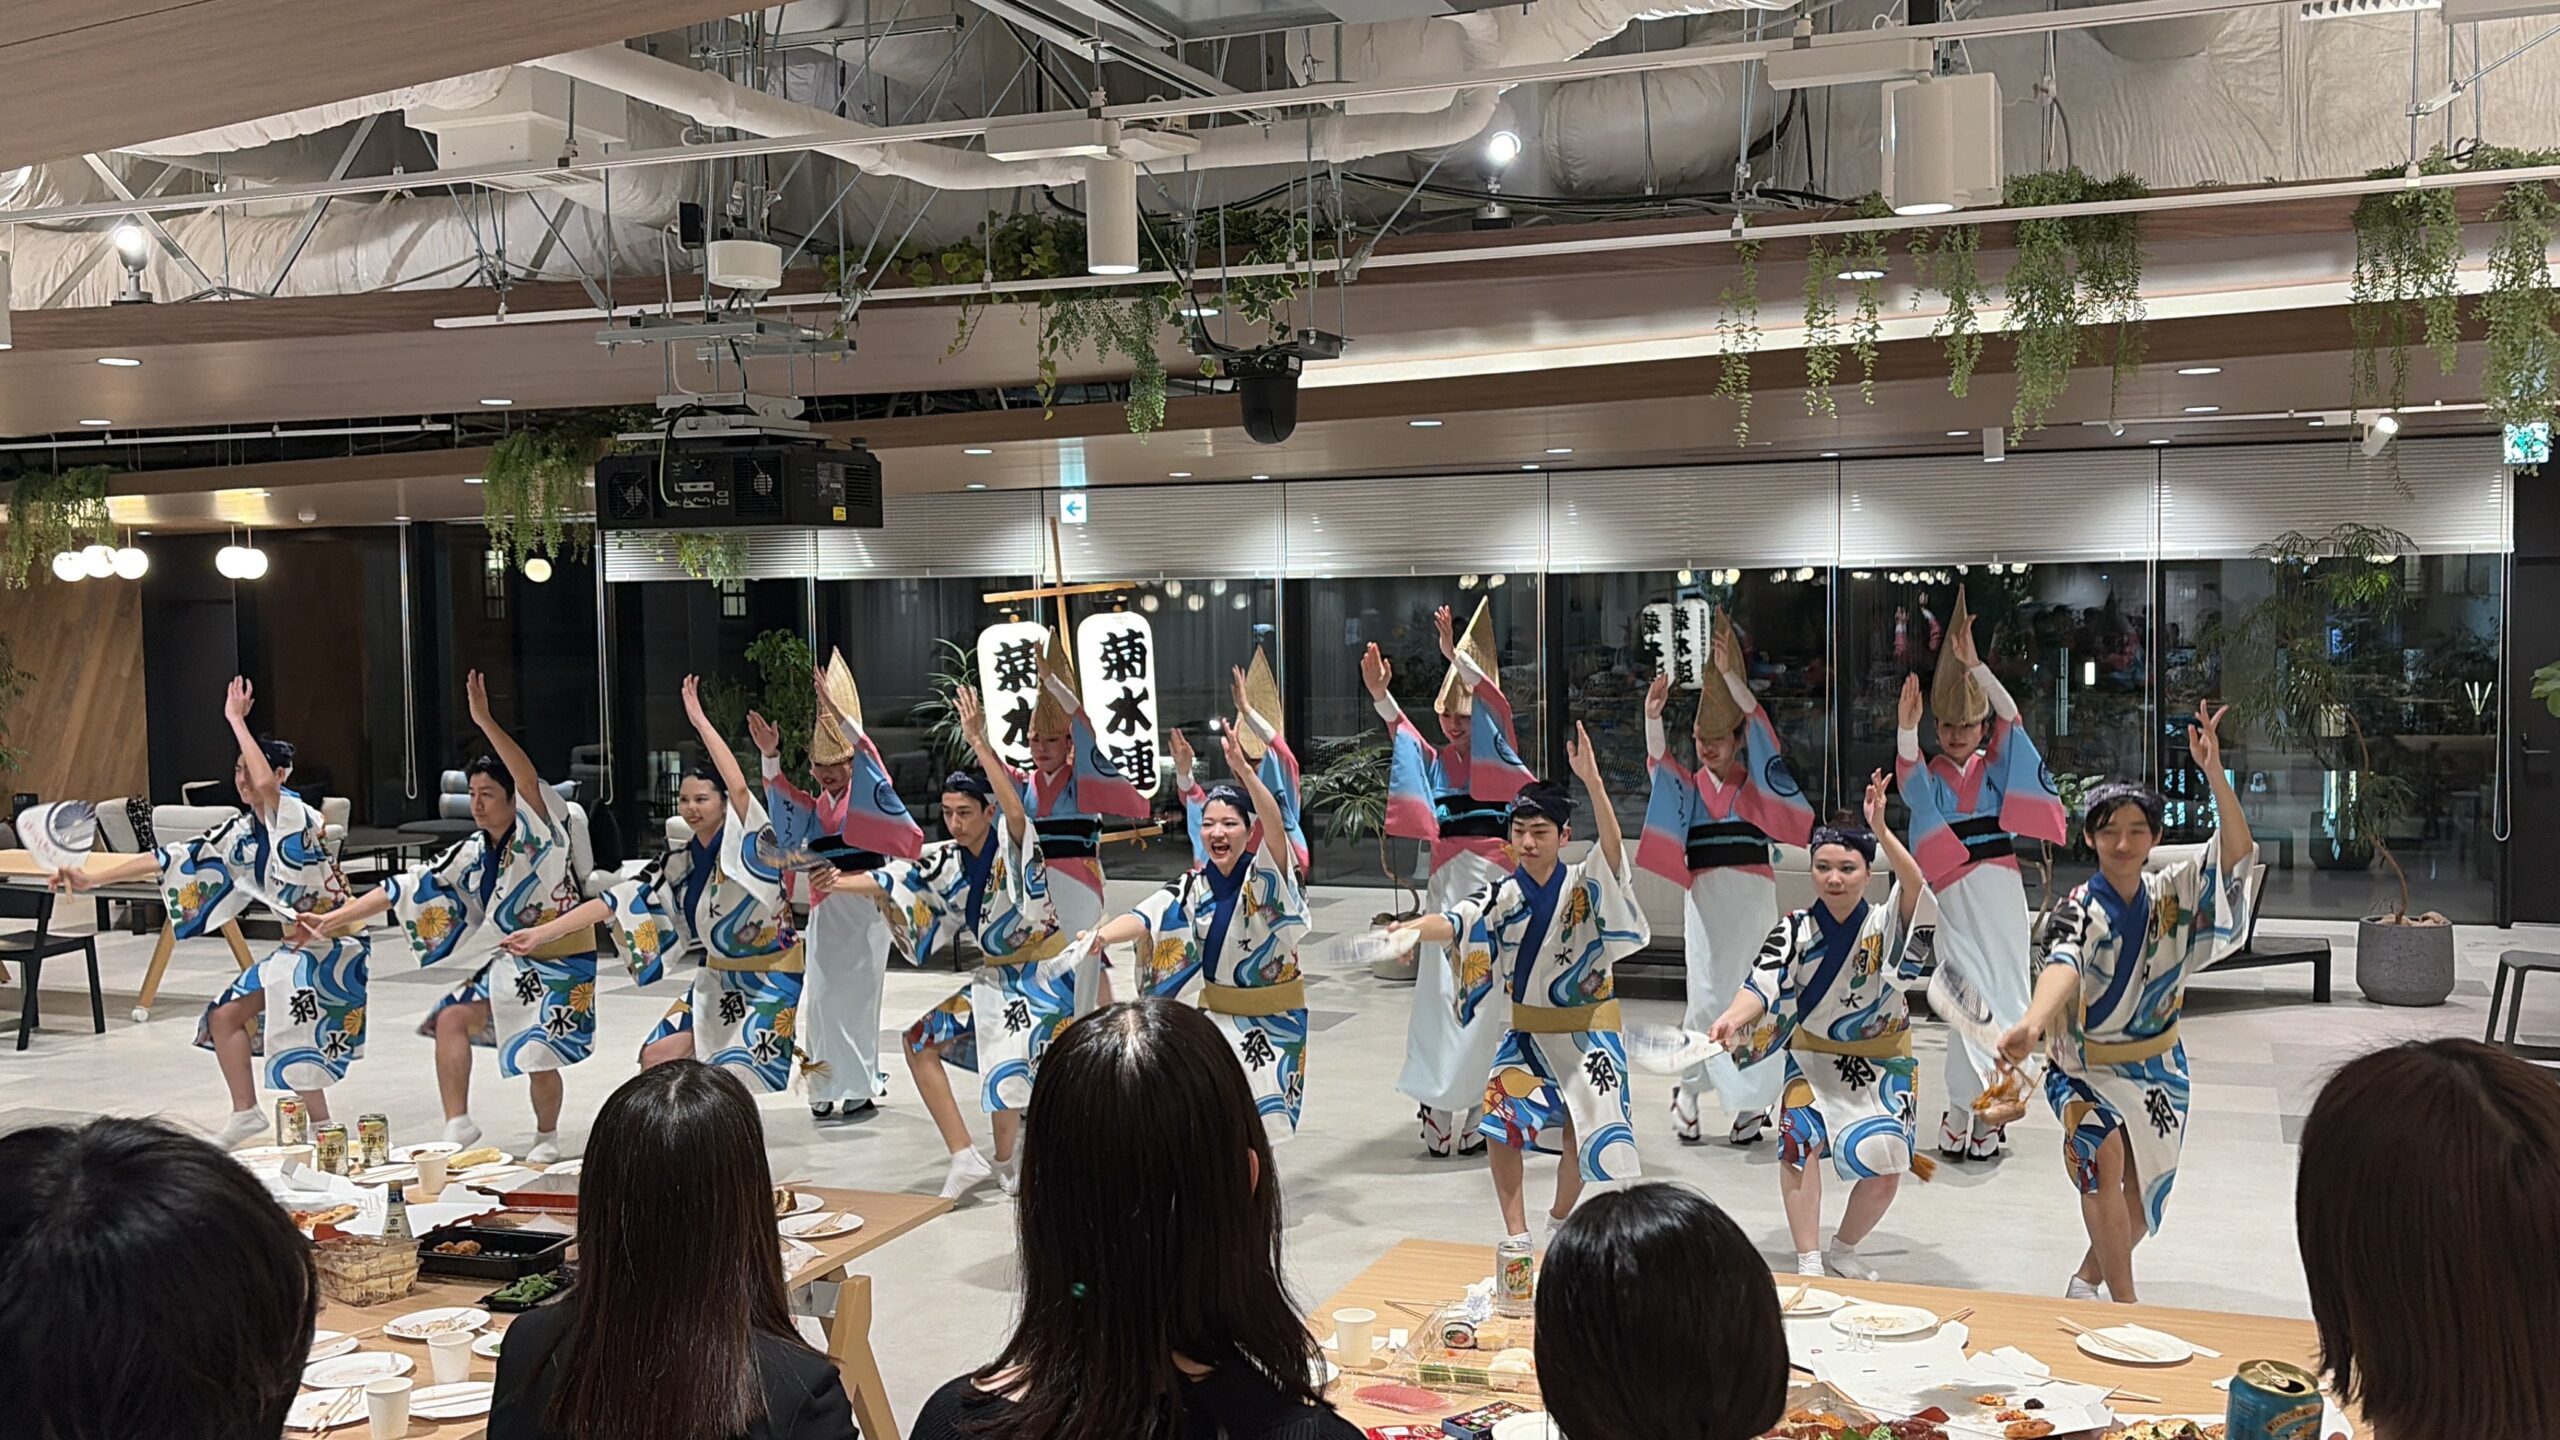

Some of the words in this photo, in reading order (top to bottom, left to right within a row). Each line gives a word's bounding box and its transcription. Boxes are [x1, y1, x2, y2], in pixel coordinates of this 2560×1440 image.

[993, 638, 1039, 775] 菊水
[1099, 628, 1157, 791] 菊水連
[1554, 946, 1573, 967] 水
